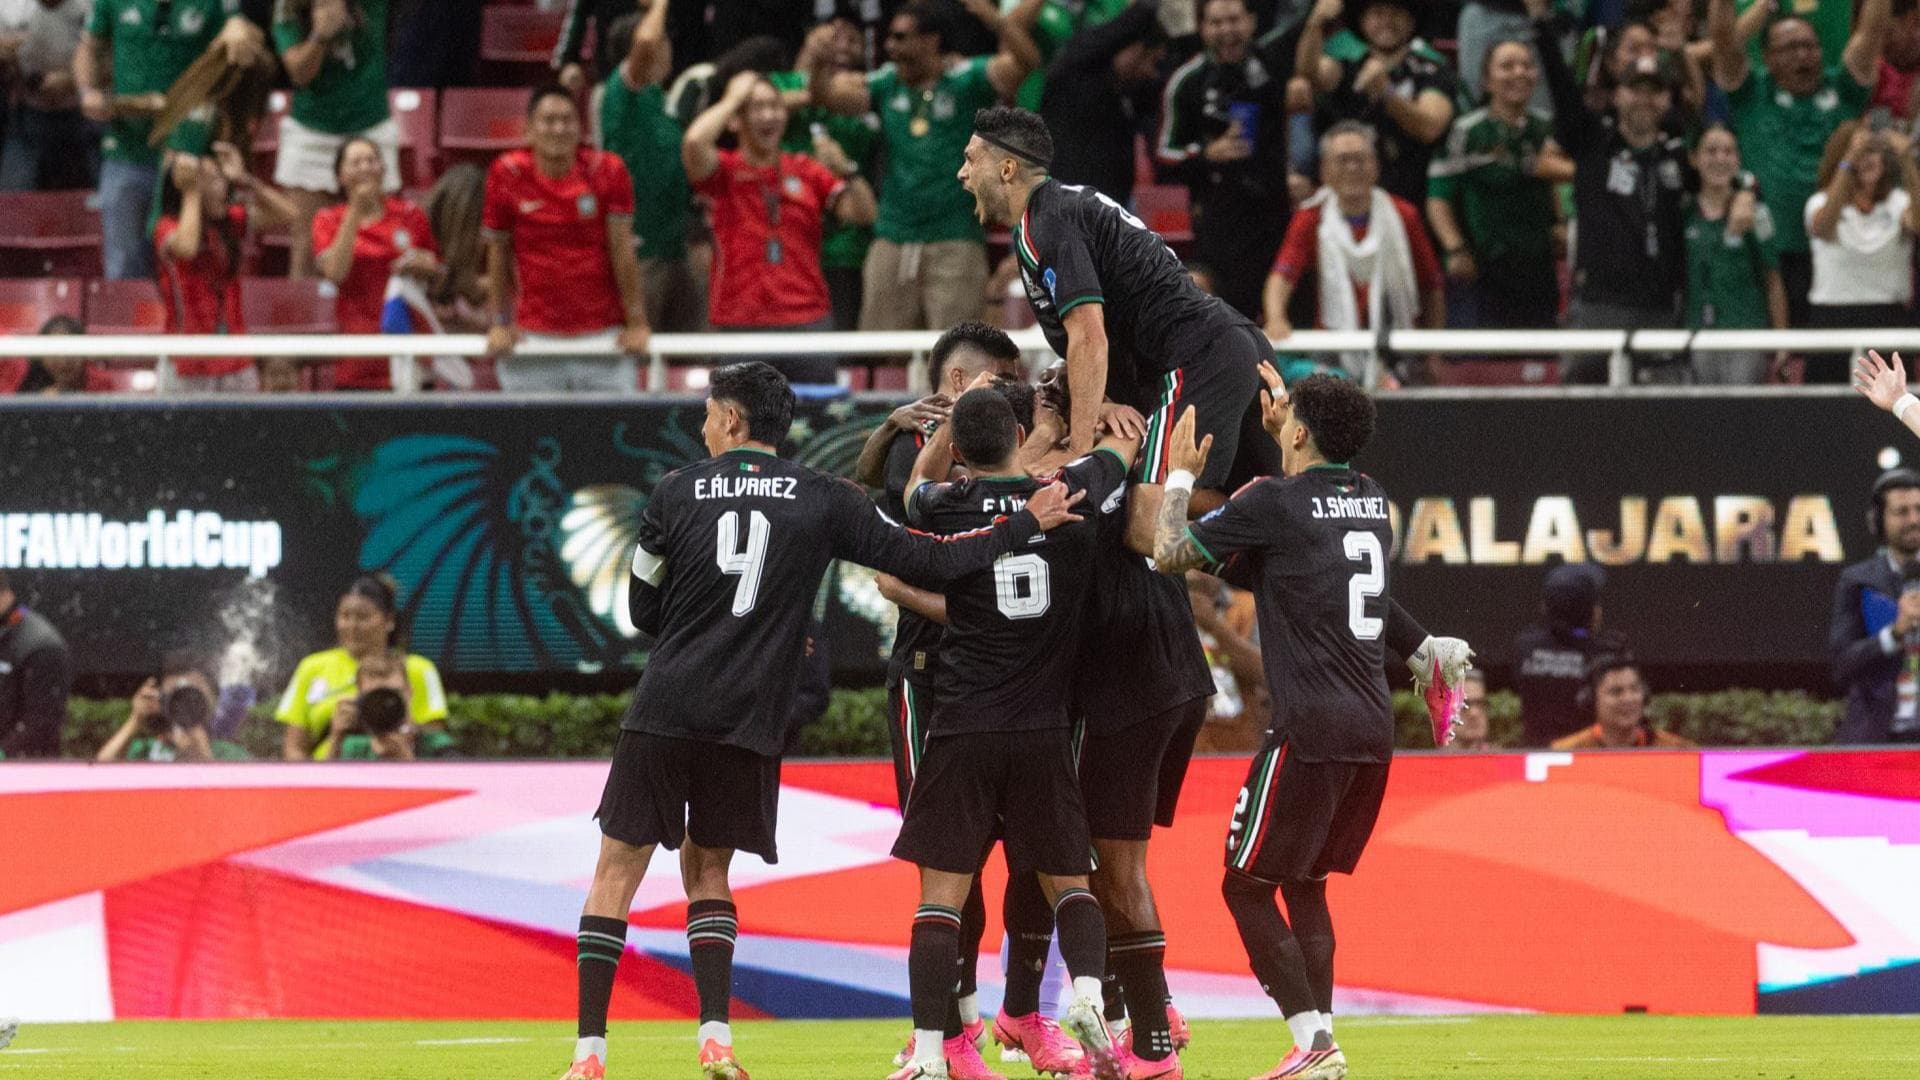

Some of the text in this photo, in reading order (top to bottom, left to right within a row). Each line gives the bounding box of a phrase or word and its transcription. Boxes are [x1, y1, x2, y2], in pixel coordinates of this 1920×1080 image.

[694, 474, 798, 500] E.ÁLVAREZ
[716, 510, 771, 617] 4
[993, 534, 1051, 620] 6
[1342, 530, 1385, 640] 2
